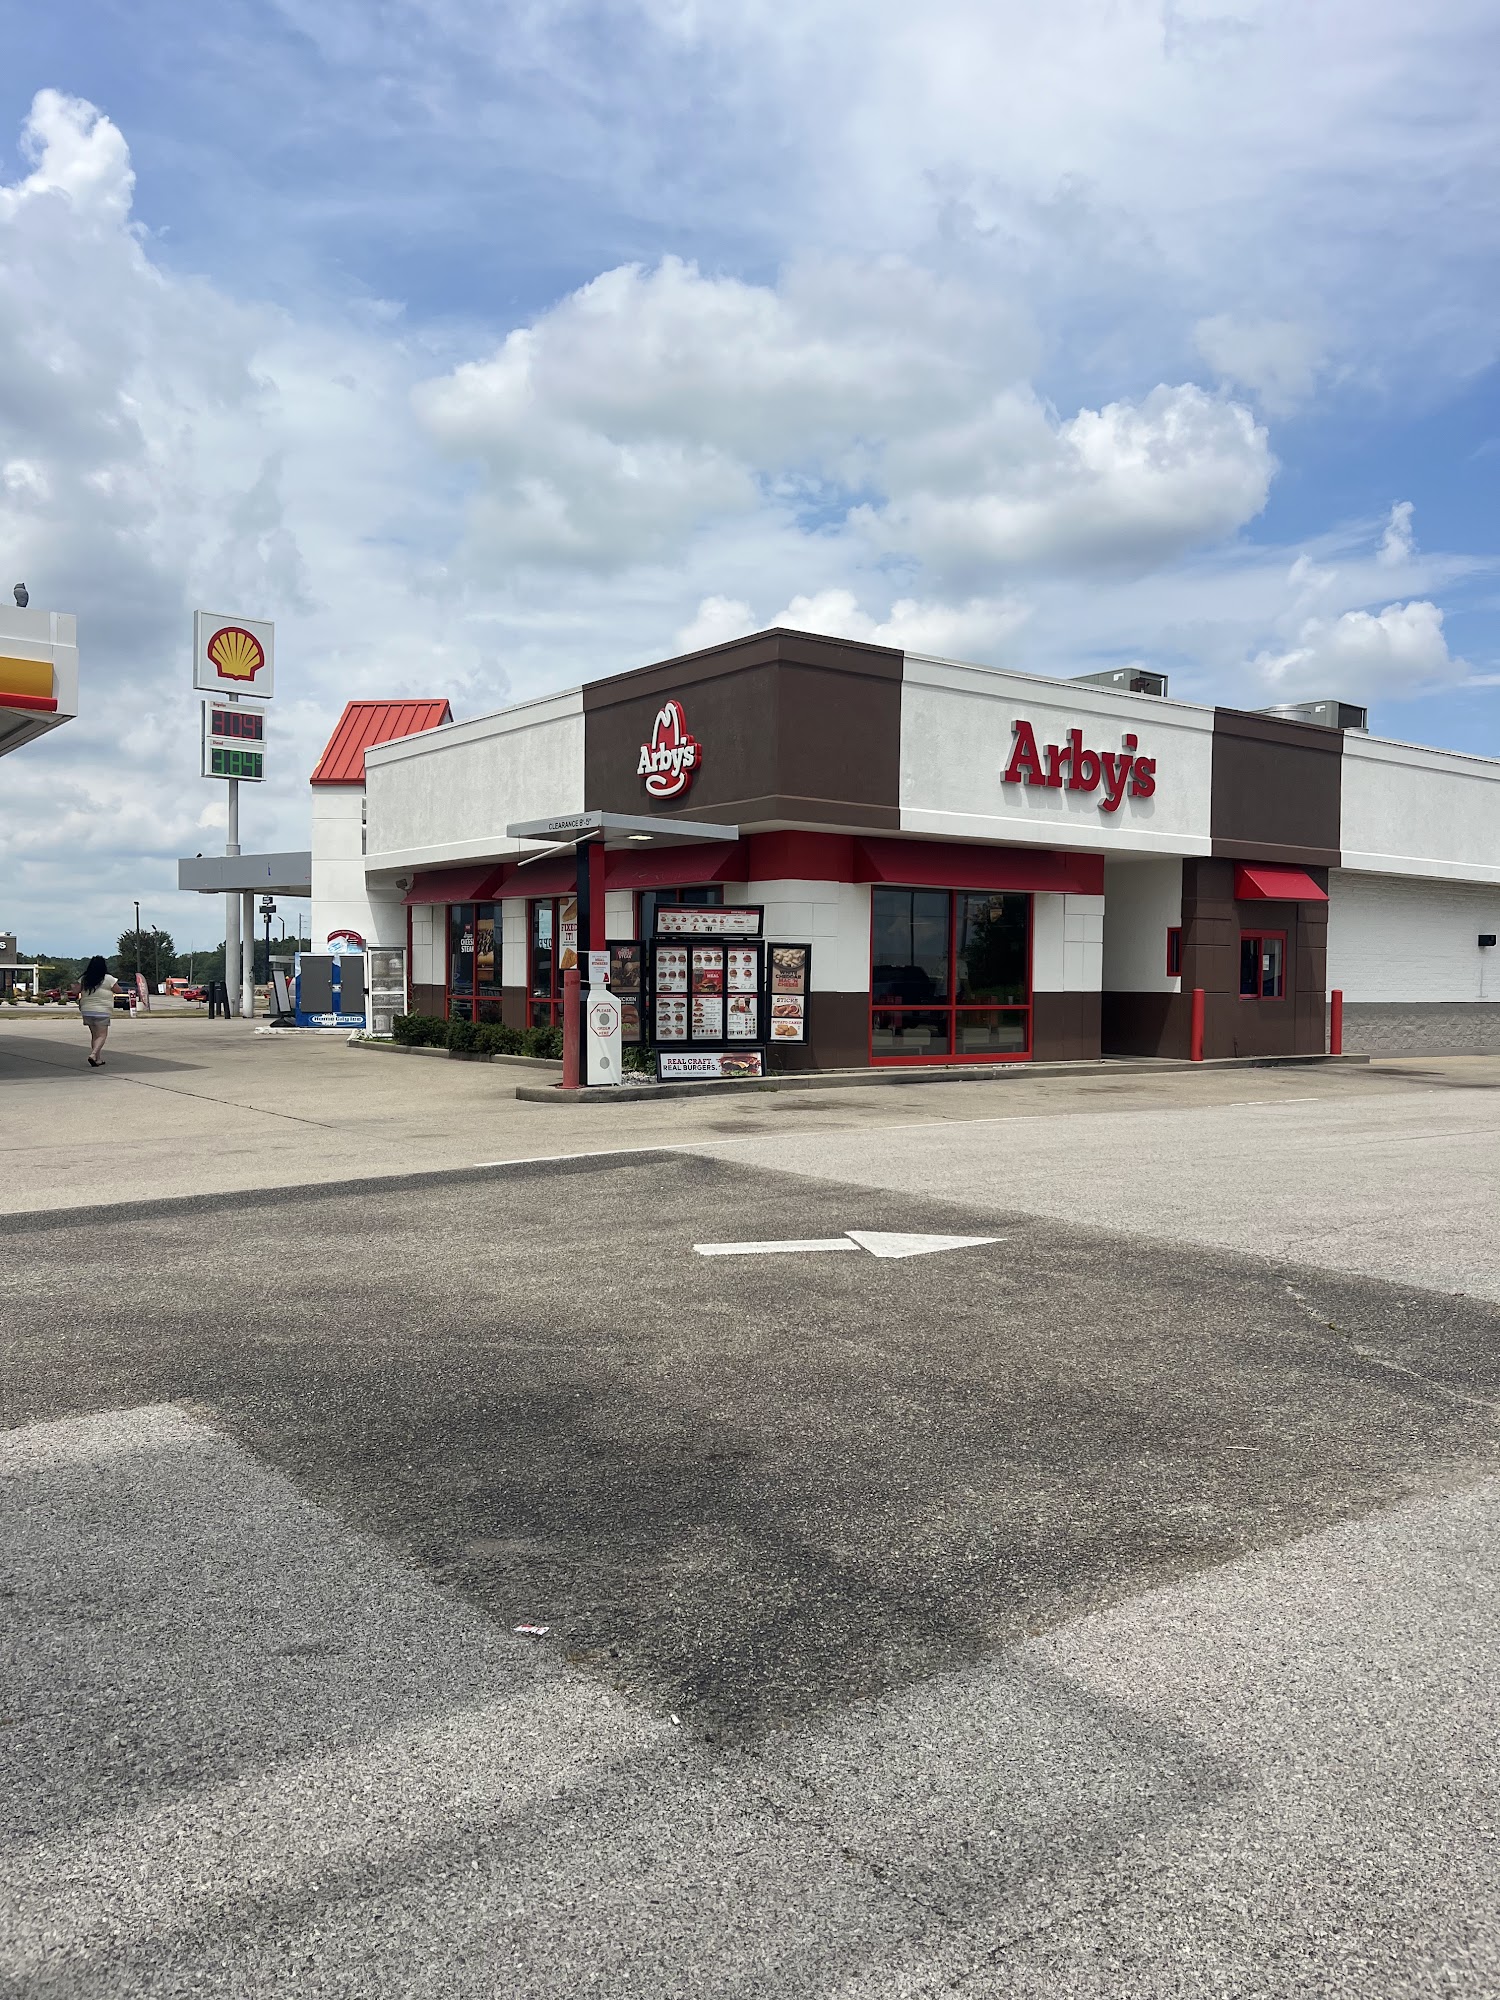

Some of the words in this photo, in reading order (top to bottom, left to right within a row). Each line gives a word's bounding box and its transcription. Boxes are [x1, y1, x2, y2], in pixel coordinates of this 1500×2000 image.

[637, 736, 695, 777] Arby's
[1000, 719, 1156, 812] Arby's
[548, 820, 579, 830] CLEARANCE
